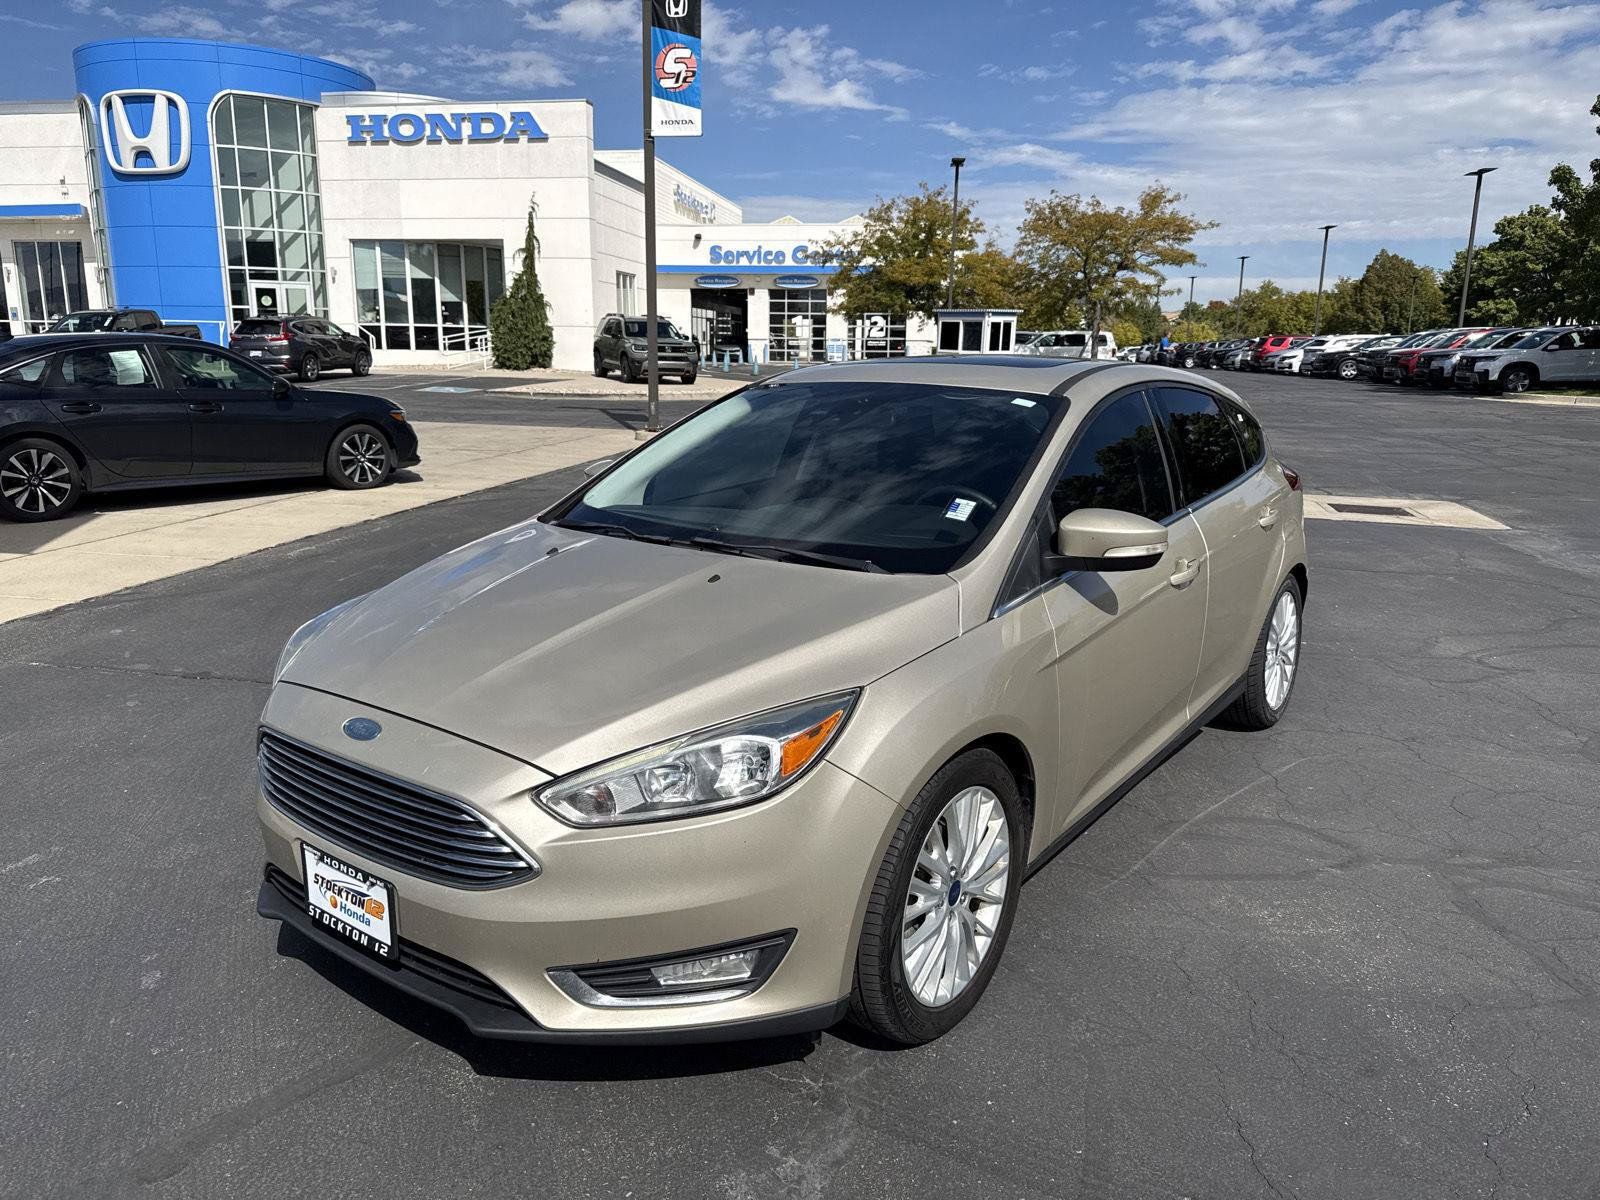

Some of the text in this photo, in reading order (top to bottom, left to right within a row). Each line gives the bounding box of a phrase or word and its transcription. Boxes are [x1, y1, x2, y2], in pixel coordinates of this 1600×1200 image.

[345, 111, 549, 146] HONDA
[709, 244, 786, 265] Service
[869, 315, 886, 338] 2
[323, 855, 364, 881] HONDA
[313, 873, 385, 920] STOCKTON 12
[339, 901, 371, 926] Honda
[308, 905, 389, 957] STOCKTON 12
